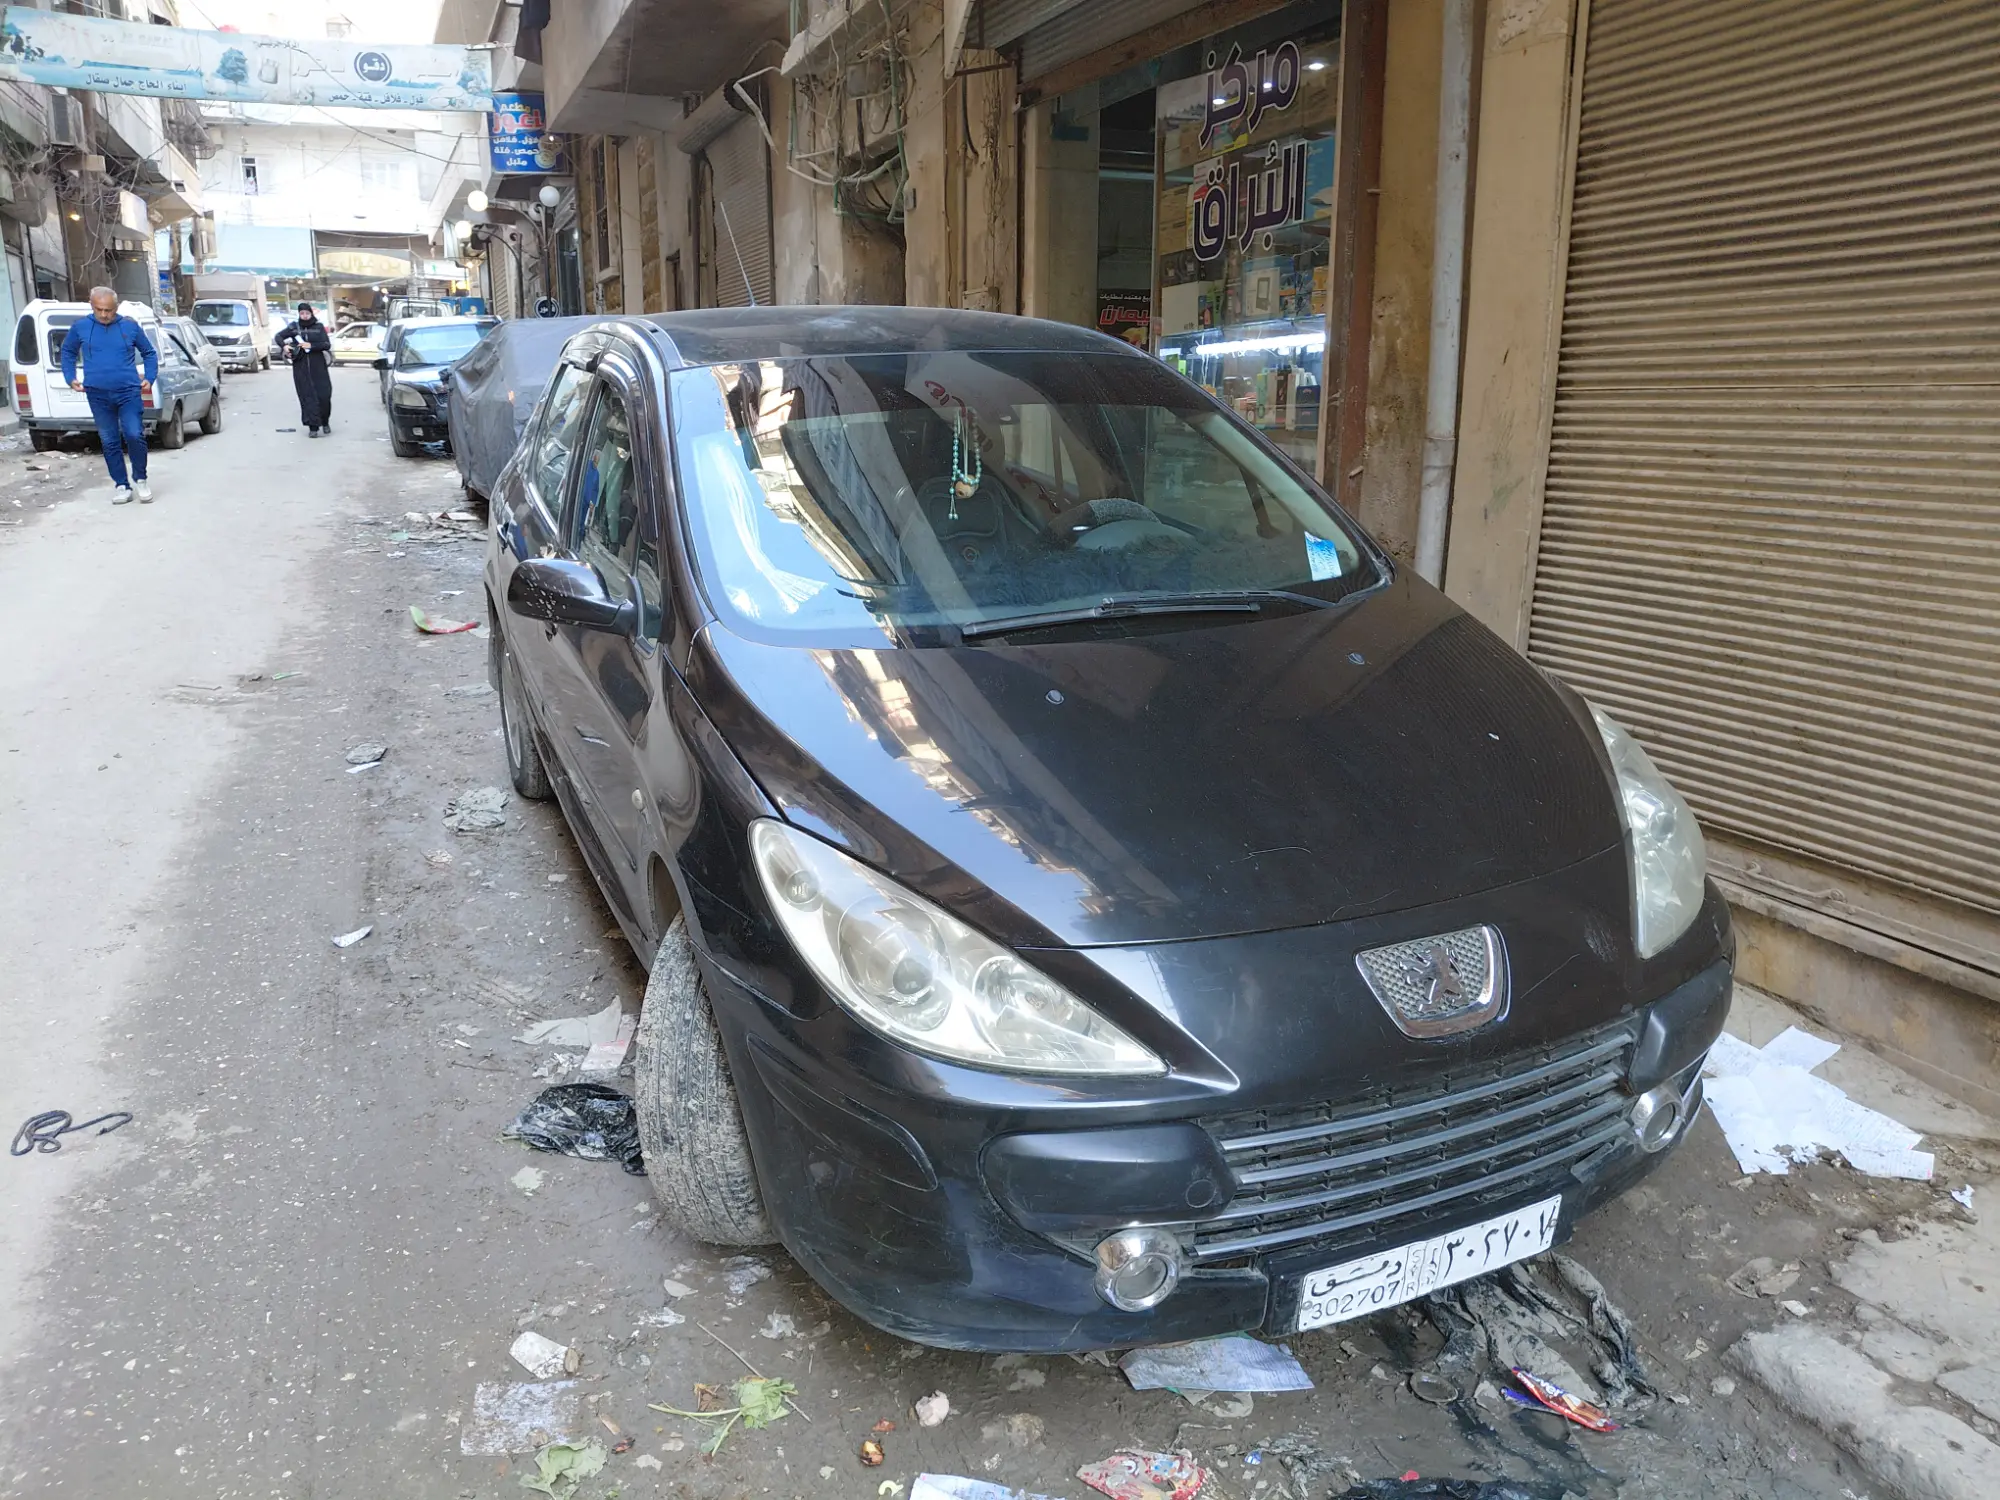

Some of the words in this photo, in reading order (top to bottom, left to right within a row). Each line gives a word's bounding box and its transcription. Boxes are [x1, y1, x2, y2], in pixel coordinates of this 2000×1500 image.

[113, 76, 134, 90] جمال
[138, 79, 163, 92] الحاج
[328, 91, 350, 103] حمص
[380, 92, 402, 105] فلافل
[410, 92, 424, 107] فول
[1198, 41, 1300, 150] مركز
[500, 102, 531, 113] مطعم
[514, 148, 540, 156] حمص
[506, 157, 528, 167] متبل
[1443, 1203, 1557, 1279] ٣٠٢٧٠٧
[1310, 1255, 1402, 1297] دمشق
[1310, 1279, 1401, 1321] 302707
